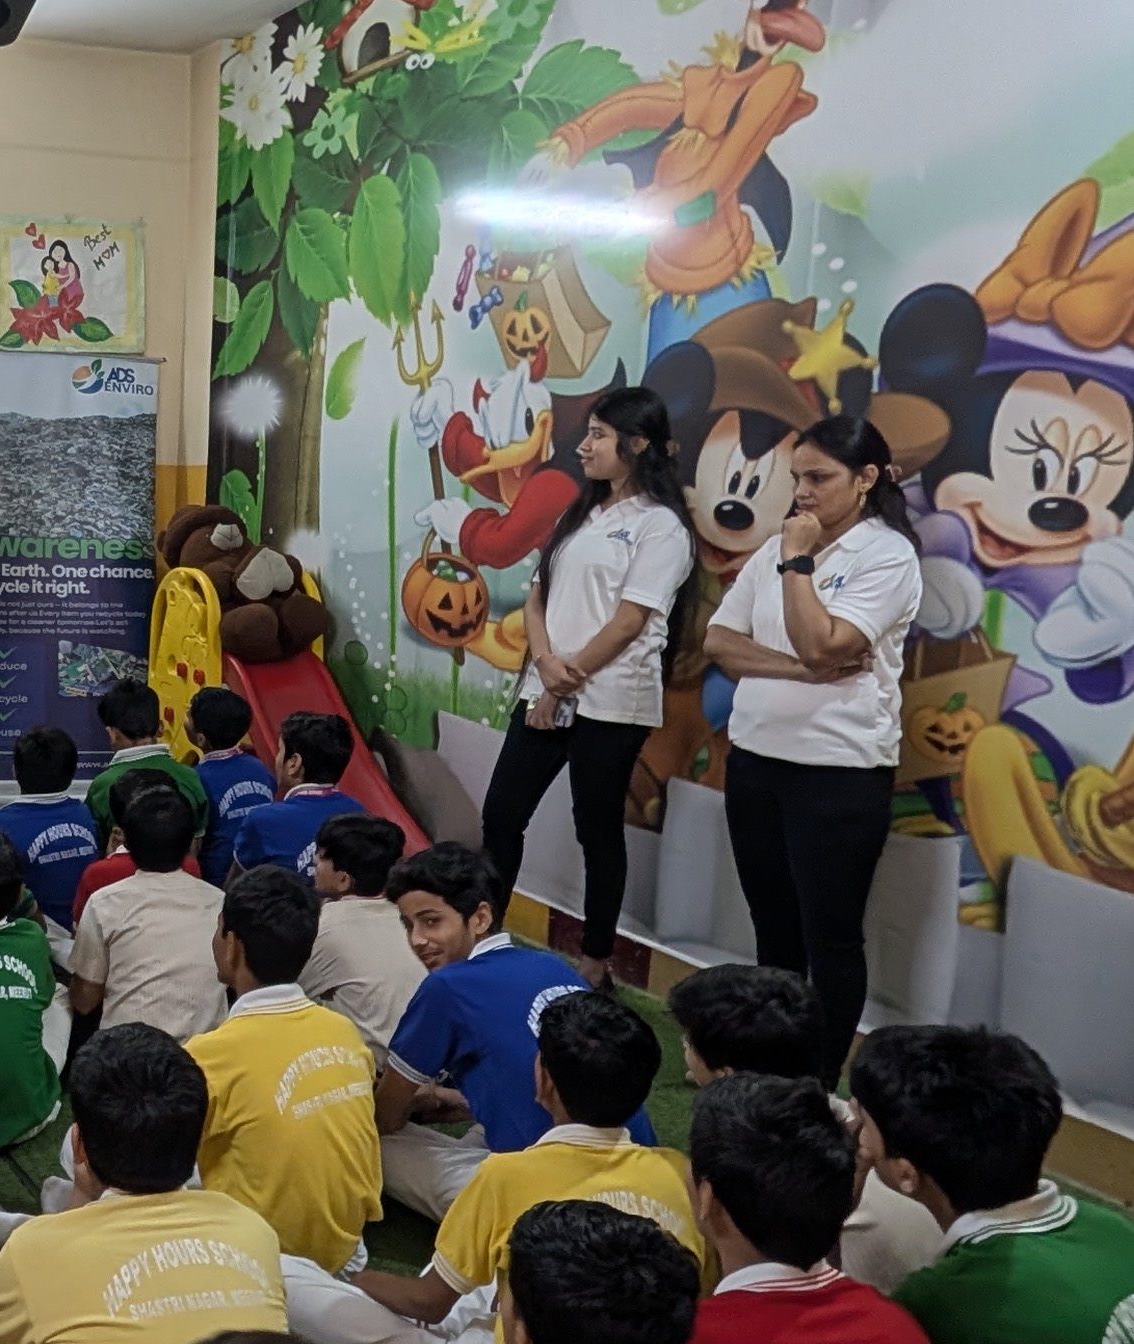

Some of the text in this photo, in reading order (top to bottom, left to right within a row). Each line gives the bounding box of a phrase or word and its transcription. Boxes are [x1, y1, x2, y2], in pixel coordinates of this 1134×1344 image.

[84, 223, 112, 252] Best
[106, 367, 136, 384] ADS
[104, 381, 155, 396] ENVIRO
[2, 564, 50, 577] Earth.
[52, 565, 88, 578] One
[90, 565, 155, 579] chance.
[32, 579, 44, 593] it
[46, 580, 91, 598] right.
[3, 954, 38, 995] SCHOOL
[102, 1250, 153, 1320] HAPPY
[151, 1238, 211, 1273] HOURS
